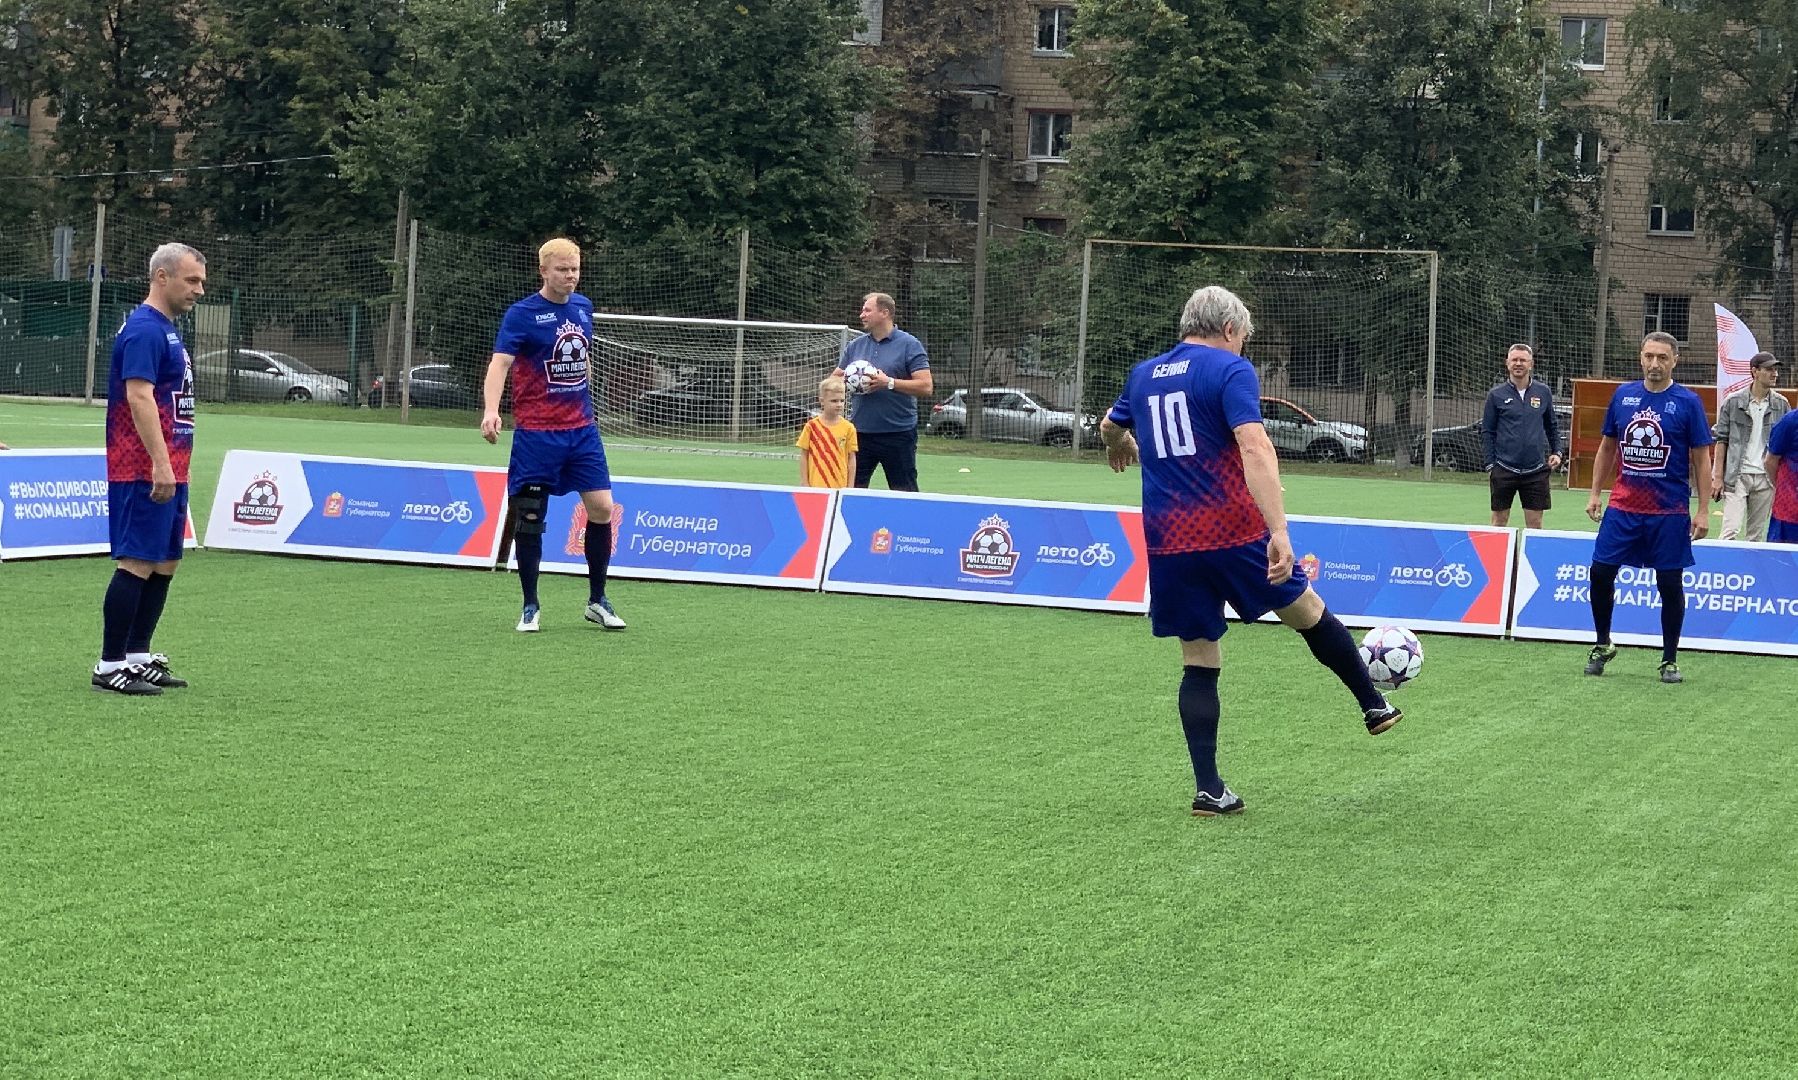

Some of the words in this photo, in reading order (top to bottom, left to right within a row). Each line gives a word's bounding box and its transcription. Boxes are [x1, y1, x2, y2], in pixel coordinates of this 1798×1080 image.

[551, 363, 570, 372] МАТЧ
[1148, 391, 1196, 459] 10
[1639, 448, 1664, 459] ЛЕГЕНД
[9, 480, 109, 499] #ВЫХОДИВОДВ
[348, 499, 379, 508] Команда
[402, 503, 441, 515] лето
[254, 506, 278, 516] ЛЕГЕНД
[345, 507, 391, 518] Губернатора
[635, 510, 719, 533] Команда
[896, 535, 930, 544] Команда
[630, 533, 752, 560] Губернатора
[895, 544, 944, 555] Губернатора
[1036, 545, 1079, 558] лето
[965, 554, 985, 563] МАТЧ
[984, 555, 1012, 566] ЛЕГЕНД
[1324, 561, 1361, 572] Команда
[1390, 566, 1434, 579] лето
[1323, 570, 1376, 582] Губернатора
